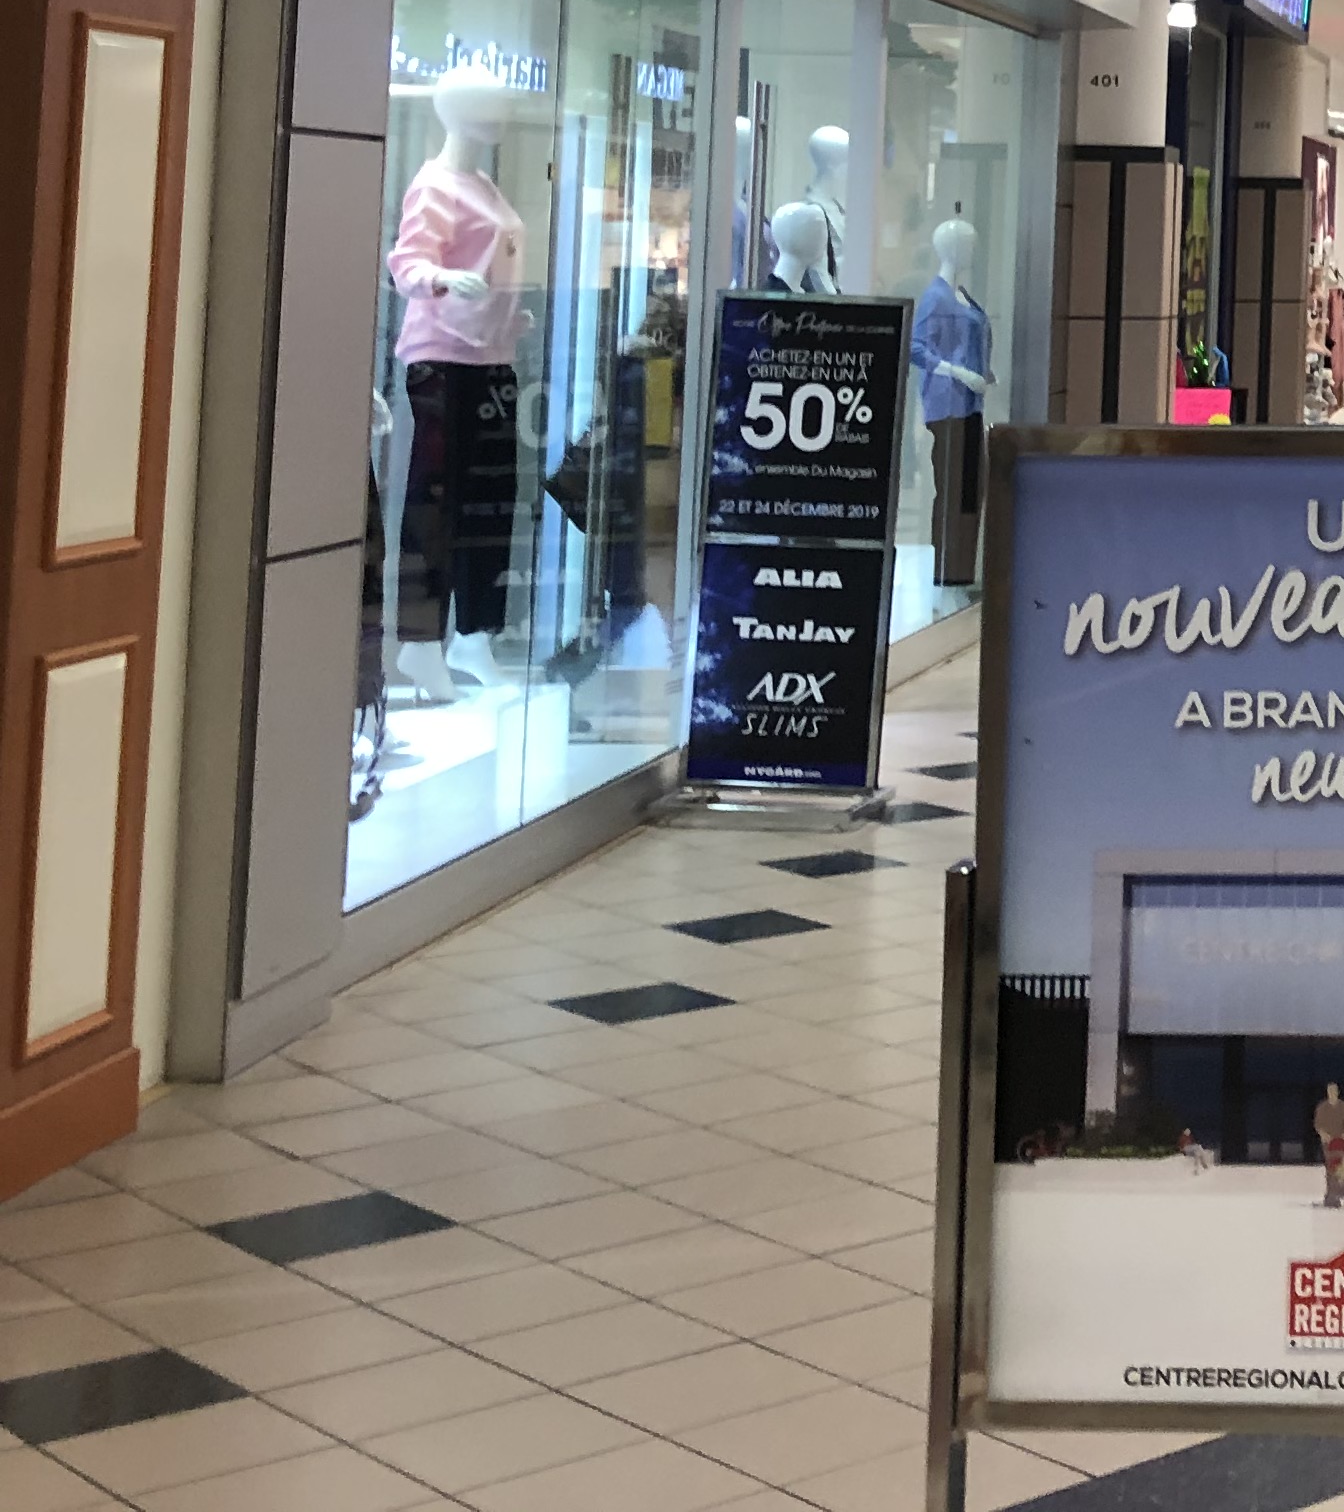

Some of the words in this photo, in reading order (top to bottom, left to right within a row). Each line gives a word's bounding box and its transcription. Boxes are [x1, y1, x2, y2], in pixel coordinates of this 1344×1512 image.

[1090, 74, 1119, 88] 401
[753, 567, 843, 589] ALIA
[746, 671, 837, 705] ADX
[1174, 691, 1211, 729] A
[741, 713, 829, 738] SLIMS
